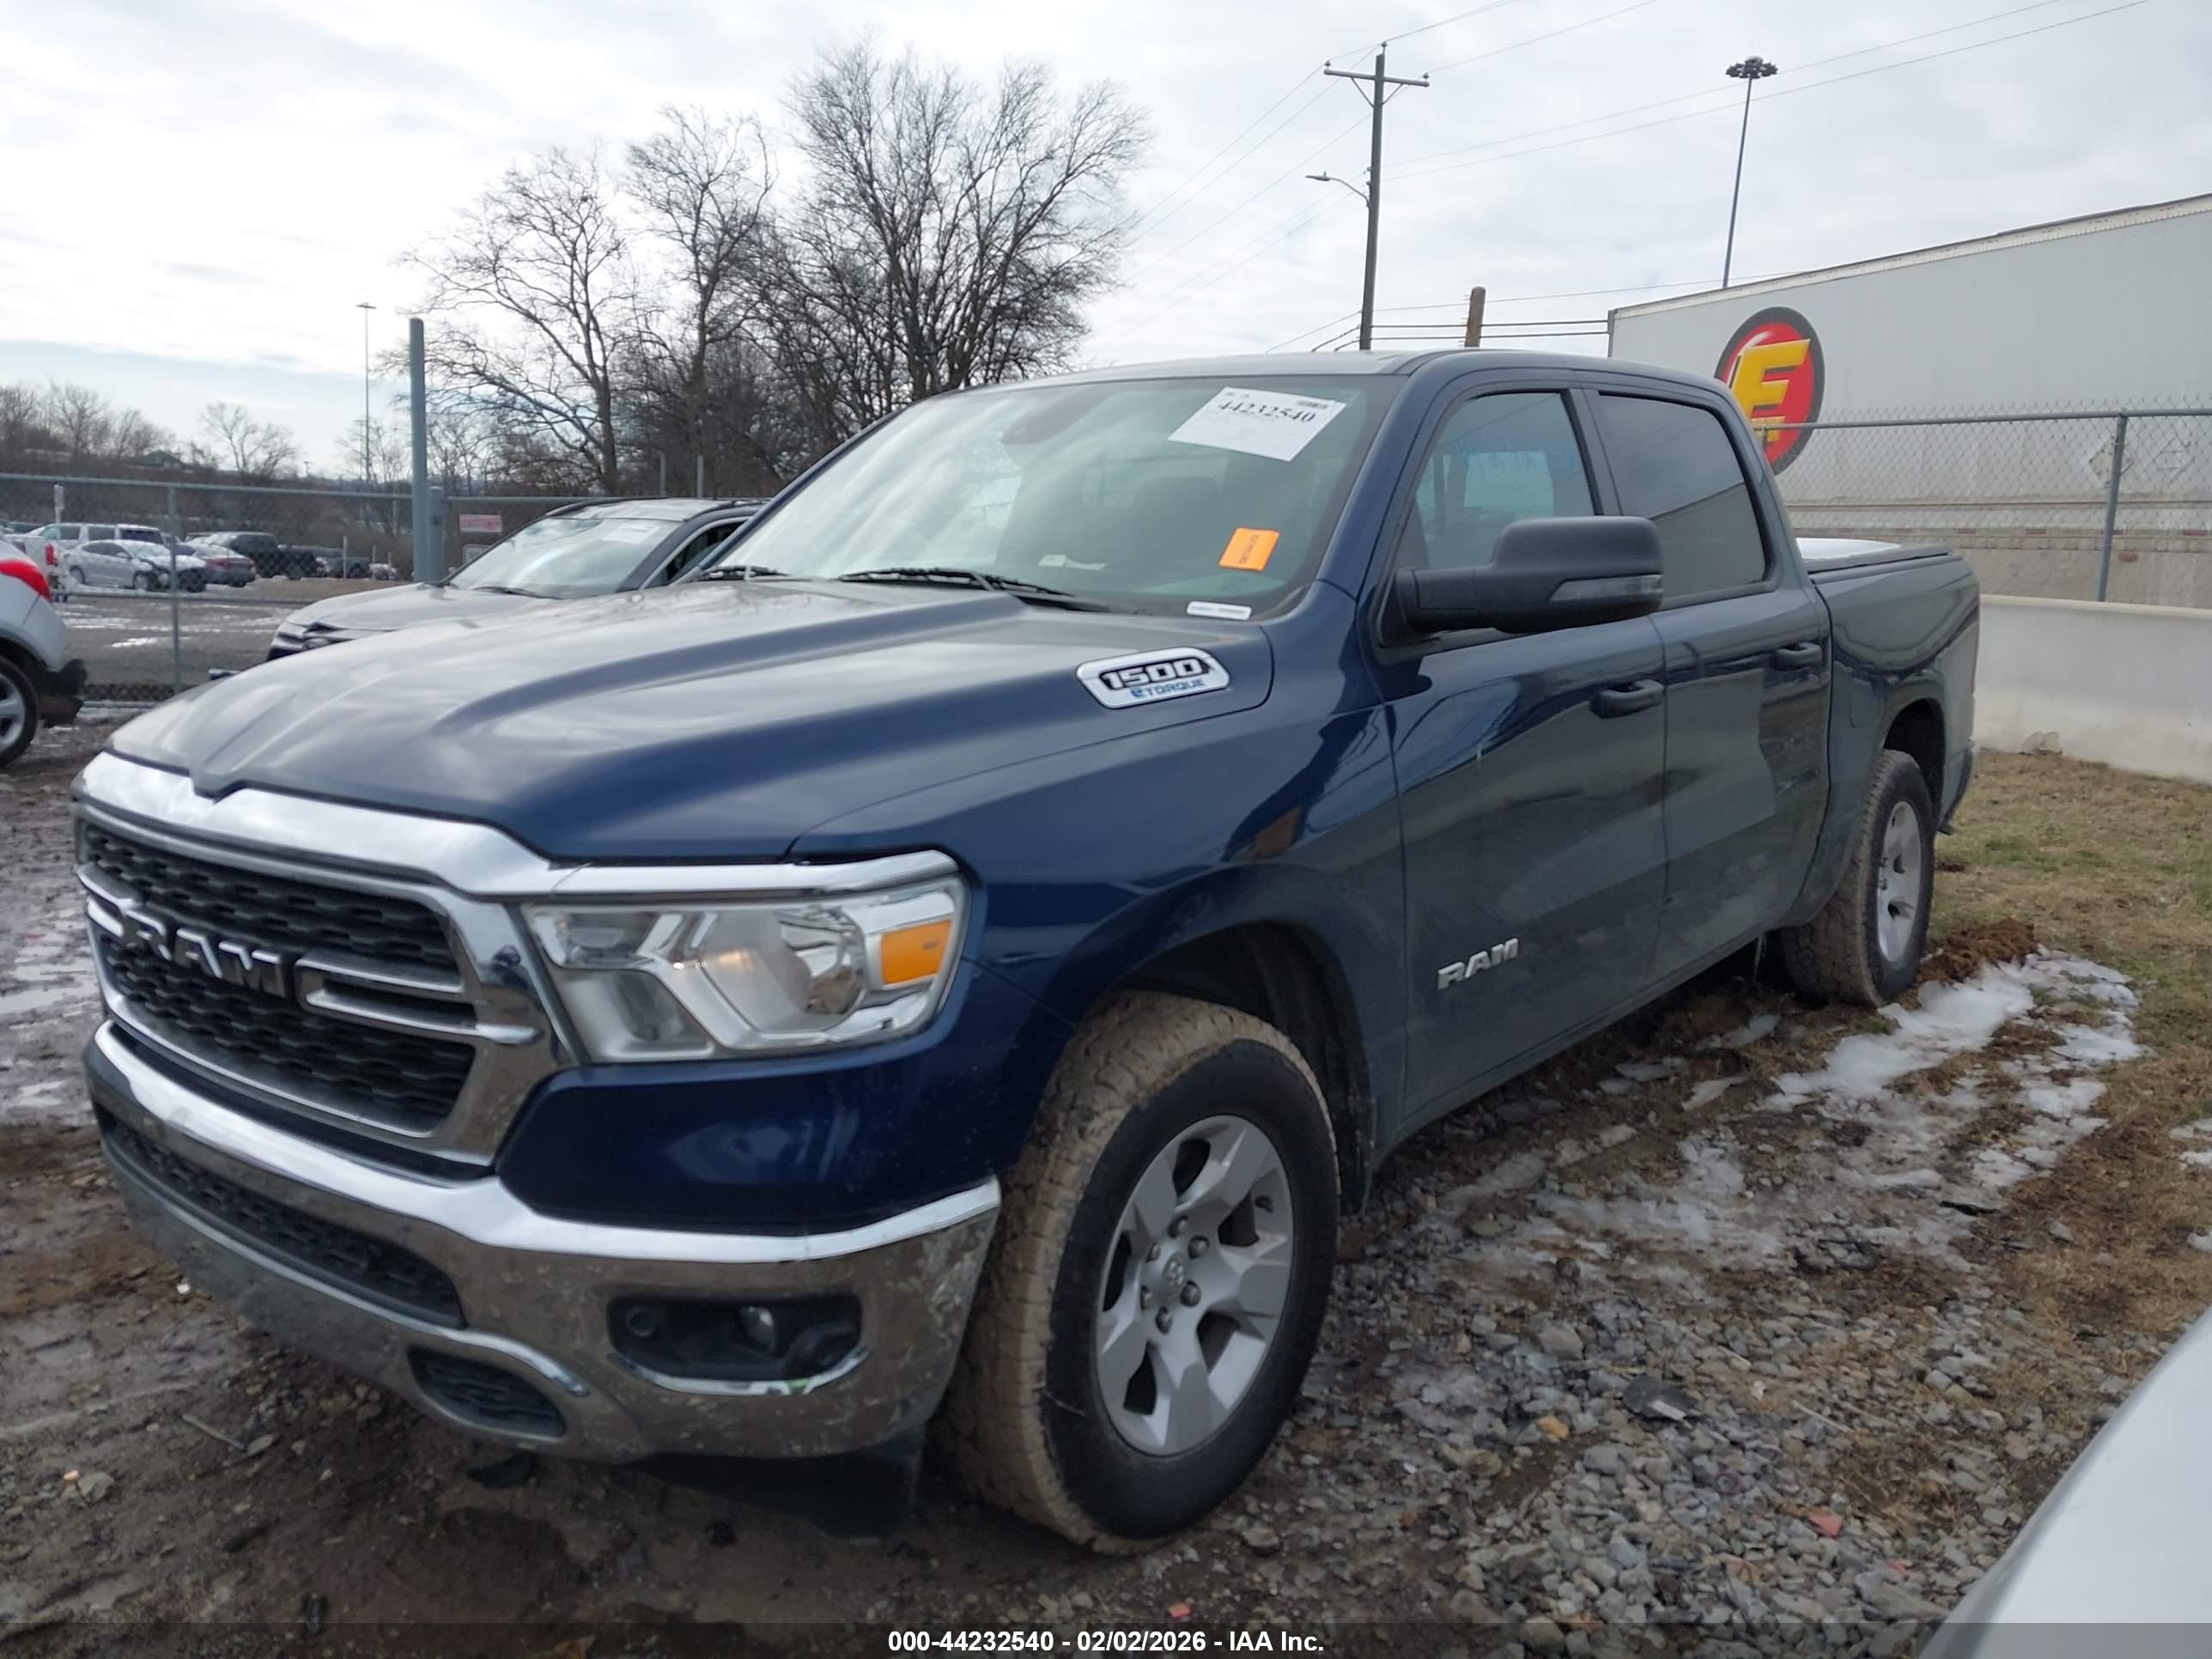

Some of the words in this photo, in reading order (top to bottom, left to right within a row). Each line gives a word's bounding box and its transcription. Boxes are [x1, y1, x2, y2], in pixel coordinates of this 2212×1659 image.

[1217, 400, 1316, 423] 44232540
[1100, 658, 1203, 690] 1500
[124, 909, 286, 998] RAM
[1437, 938, 1519, 990] RAM
